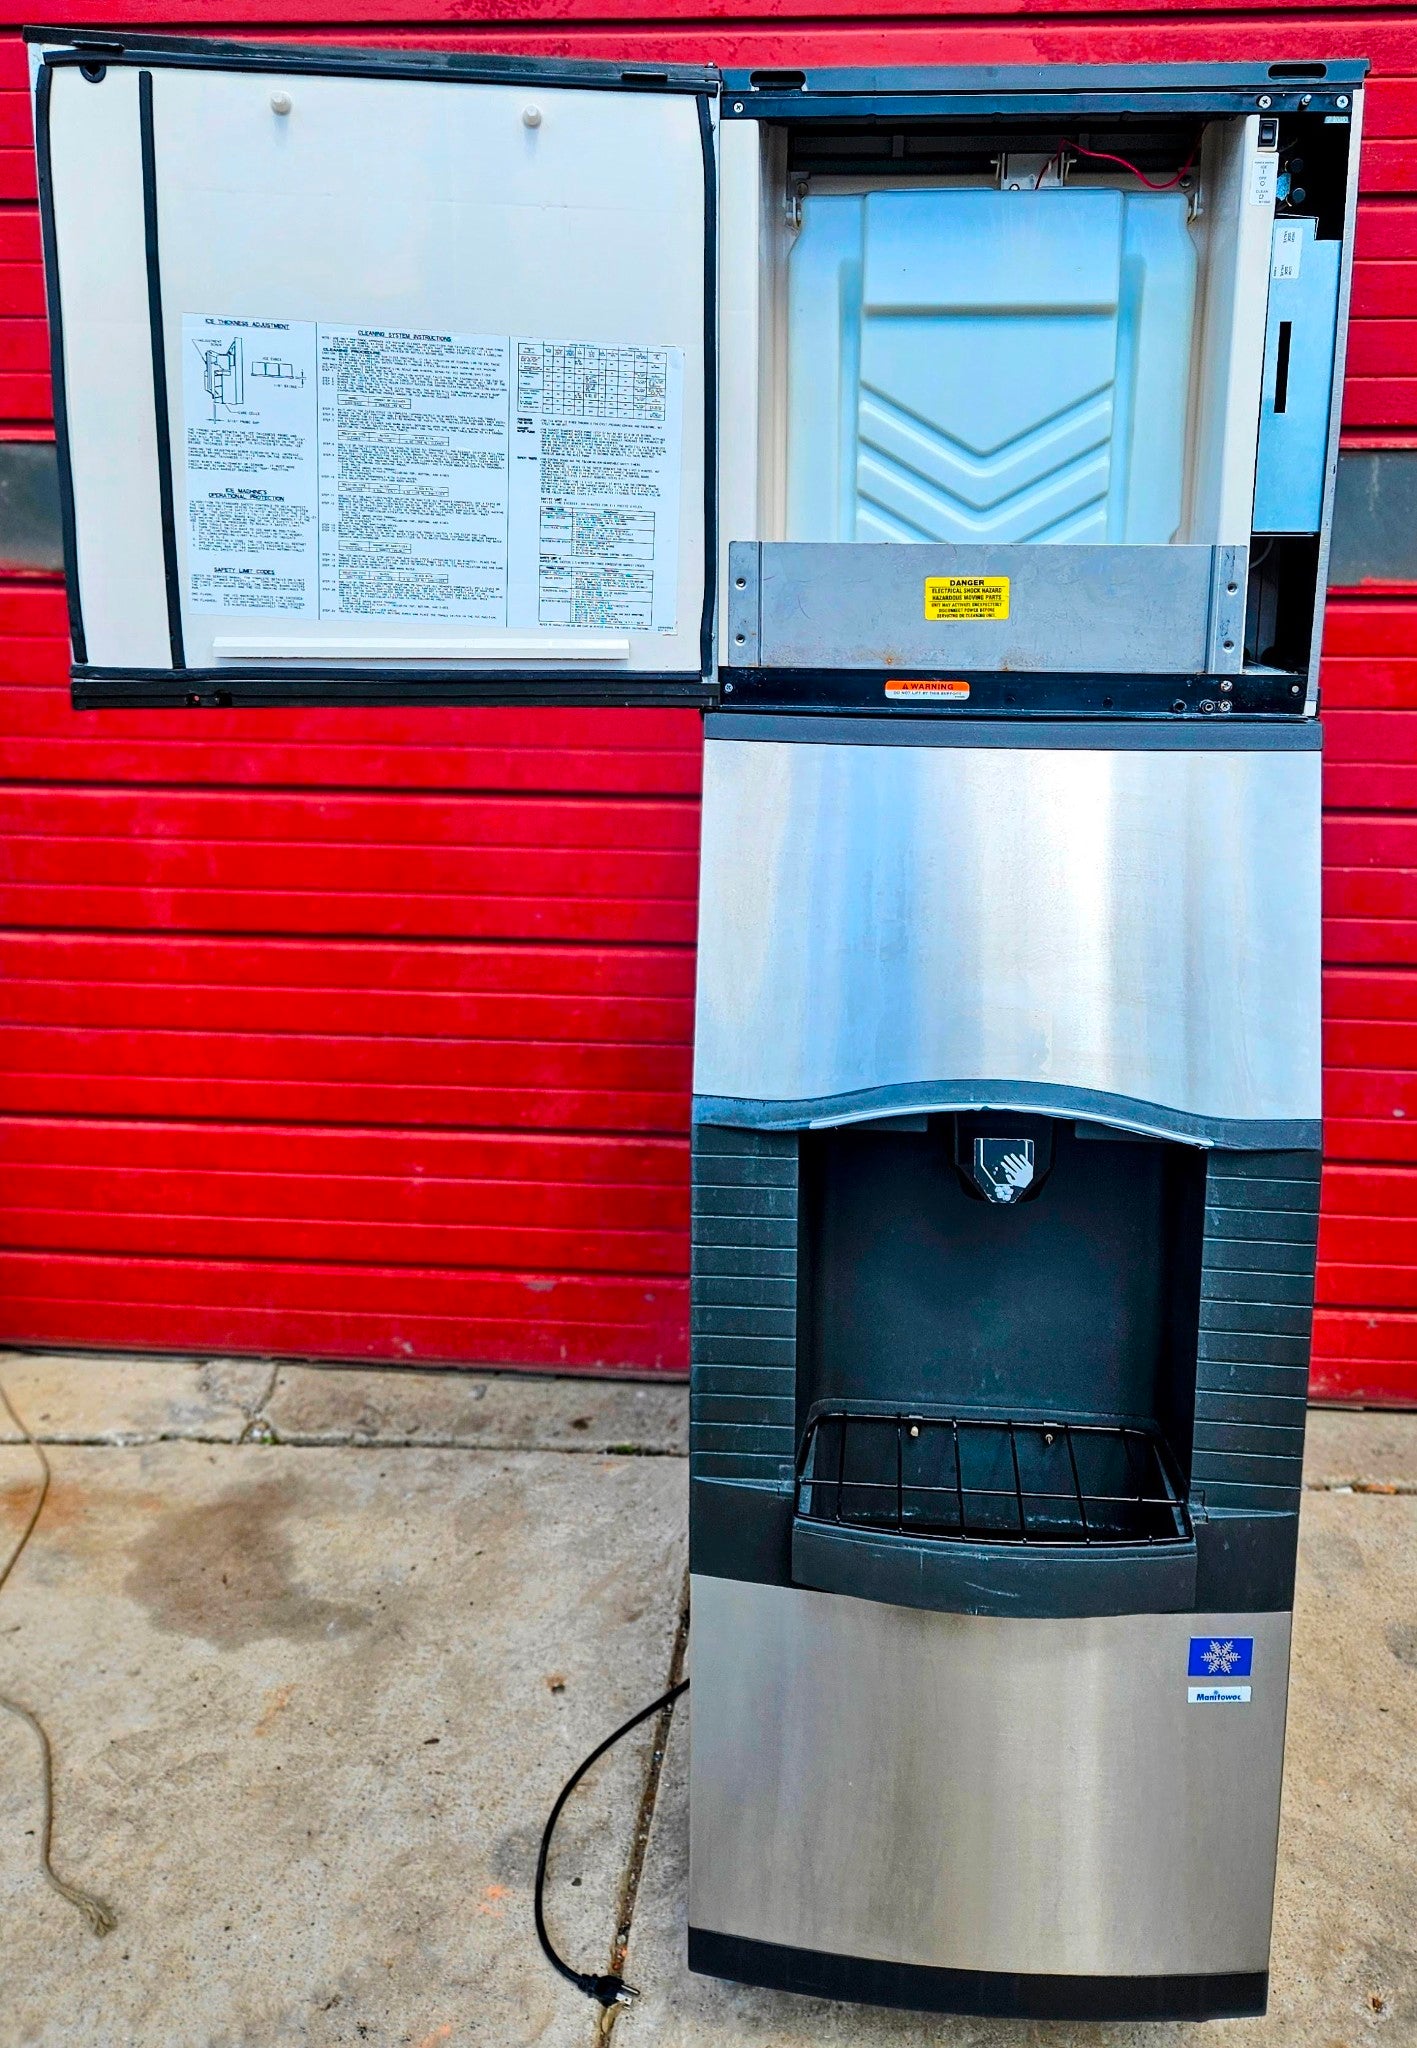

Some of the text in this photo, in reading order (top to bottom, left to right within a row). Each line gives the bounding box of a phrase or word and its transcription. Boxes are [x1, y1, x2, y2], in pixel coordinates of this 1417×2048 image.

[252, 322, 290, 330] ADJUSTMENT
[413, 334, 452, 342] INSTRUCTIONS
[1196, 1691, 1242, 1701] Manitowoc
